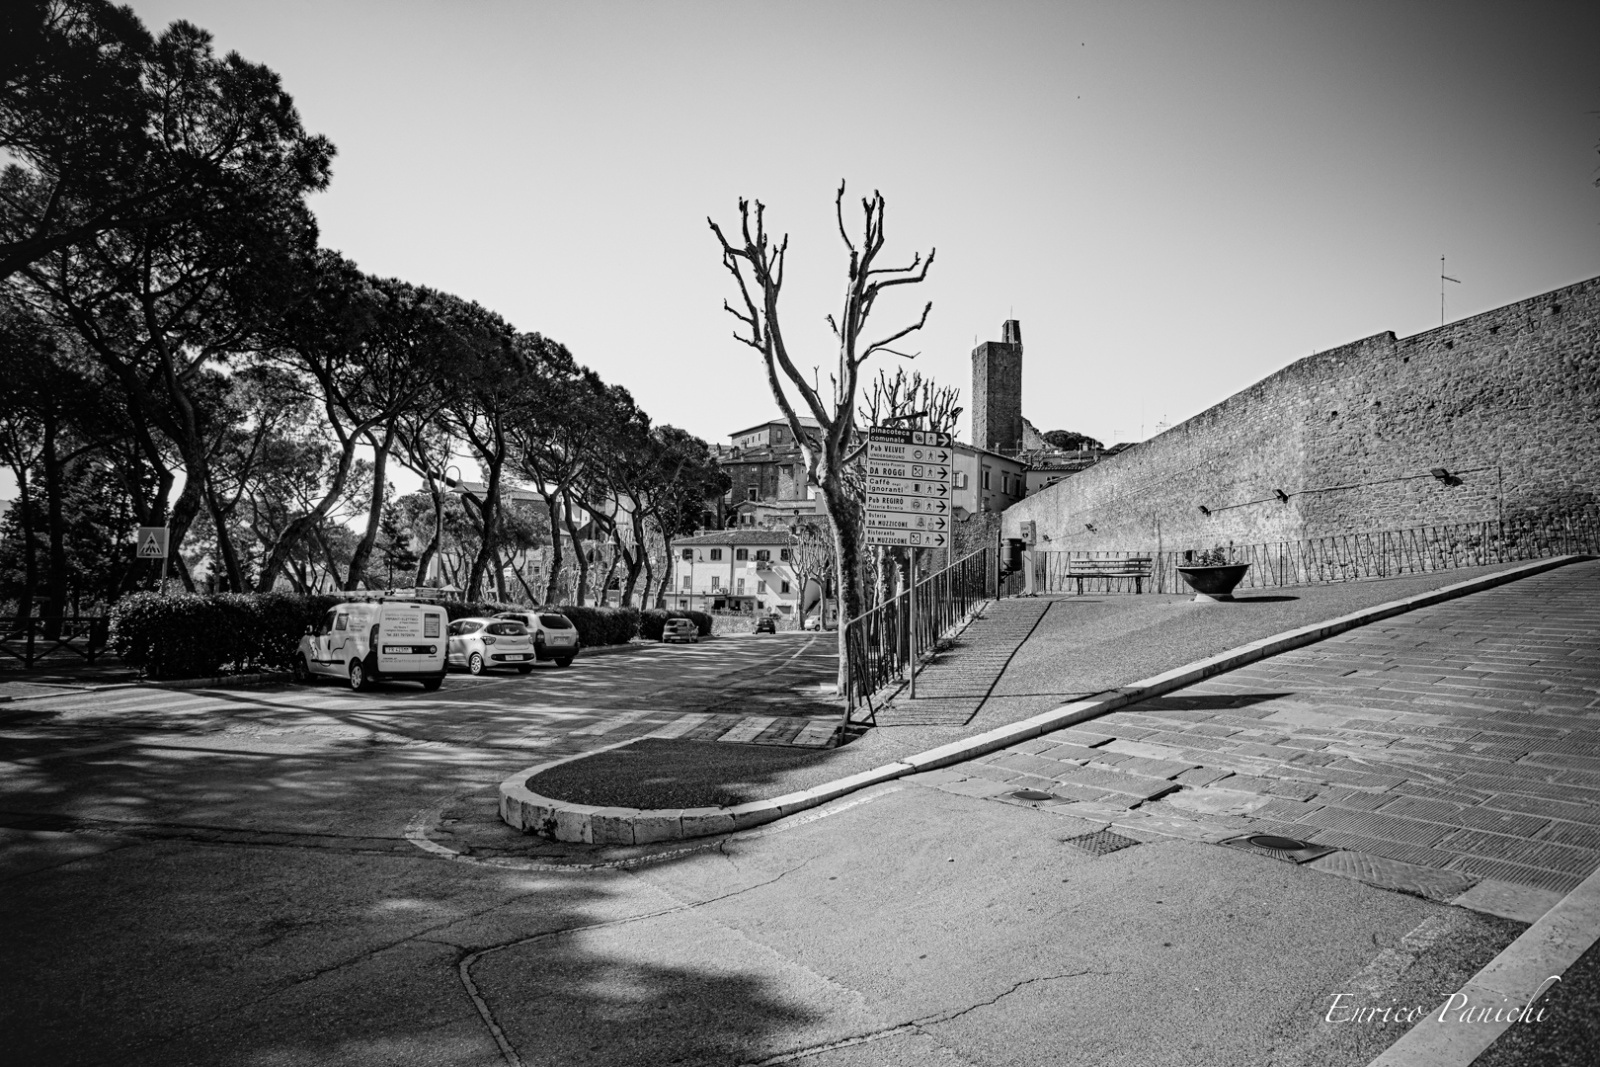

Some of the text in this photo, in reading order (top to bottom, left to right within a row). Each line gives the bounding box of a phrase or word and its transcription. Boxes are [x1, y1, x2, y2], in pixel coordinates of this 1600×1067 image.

[870, 427, 910, 436] pinacoteca
[870, 436, 905, 444] comunale
[870, 444, 905, 454] Pub VELVET
[869, 466, 905, 477] DA ROGGI
[869, 478, 890, 486] Caffè
[869, 485, 904, 493] Ignoranti
[868, 496, 880, 504] Pub
